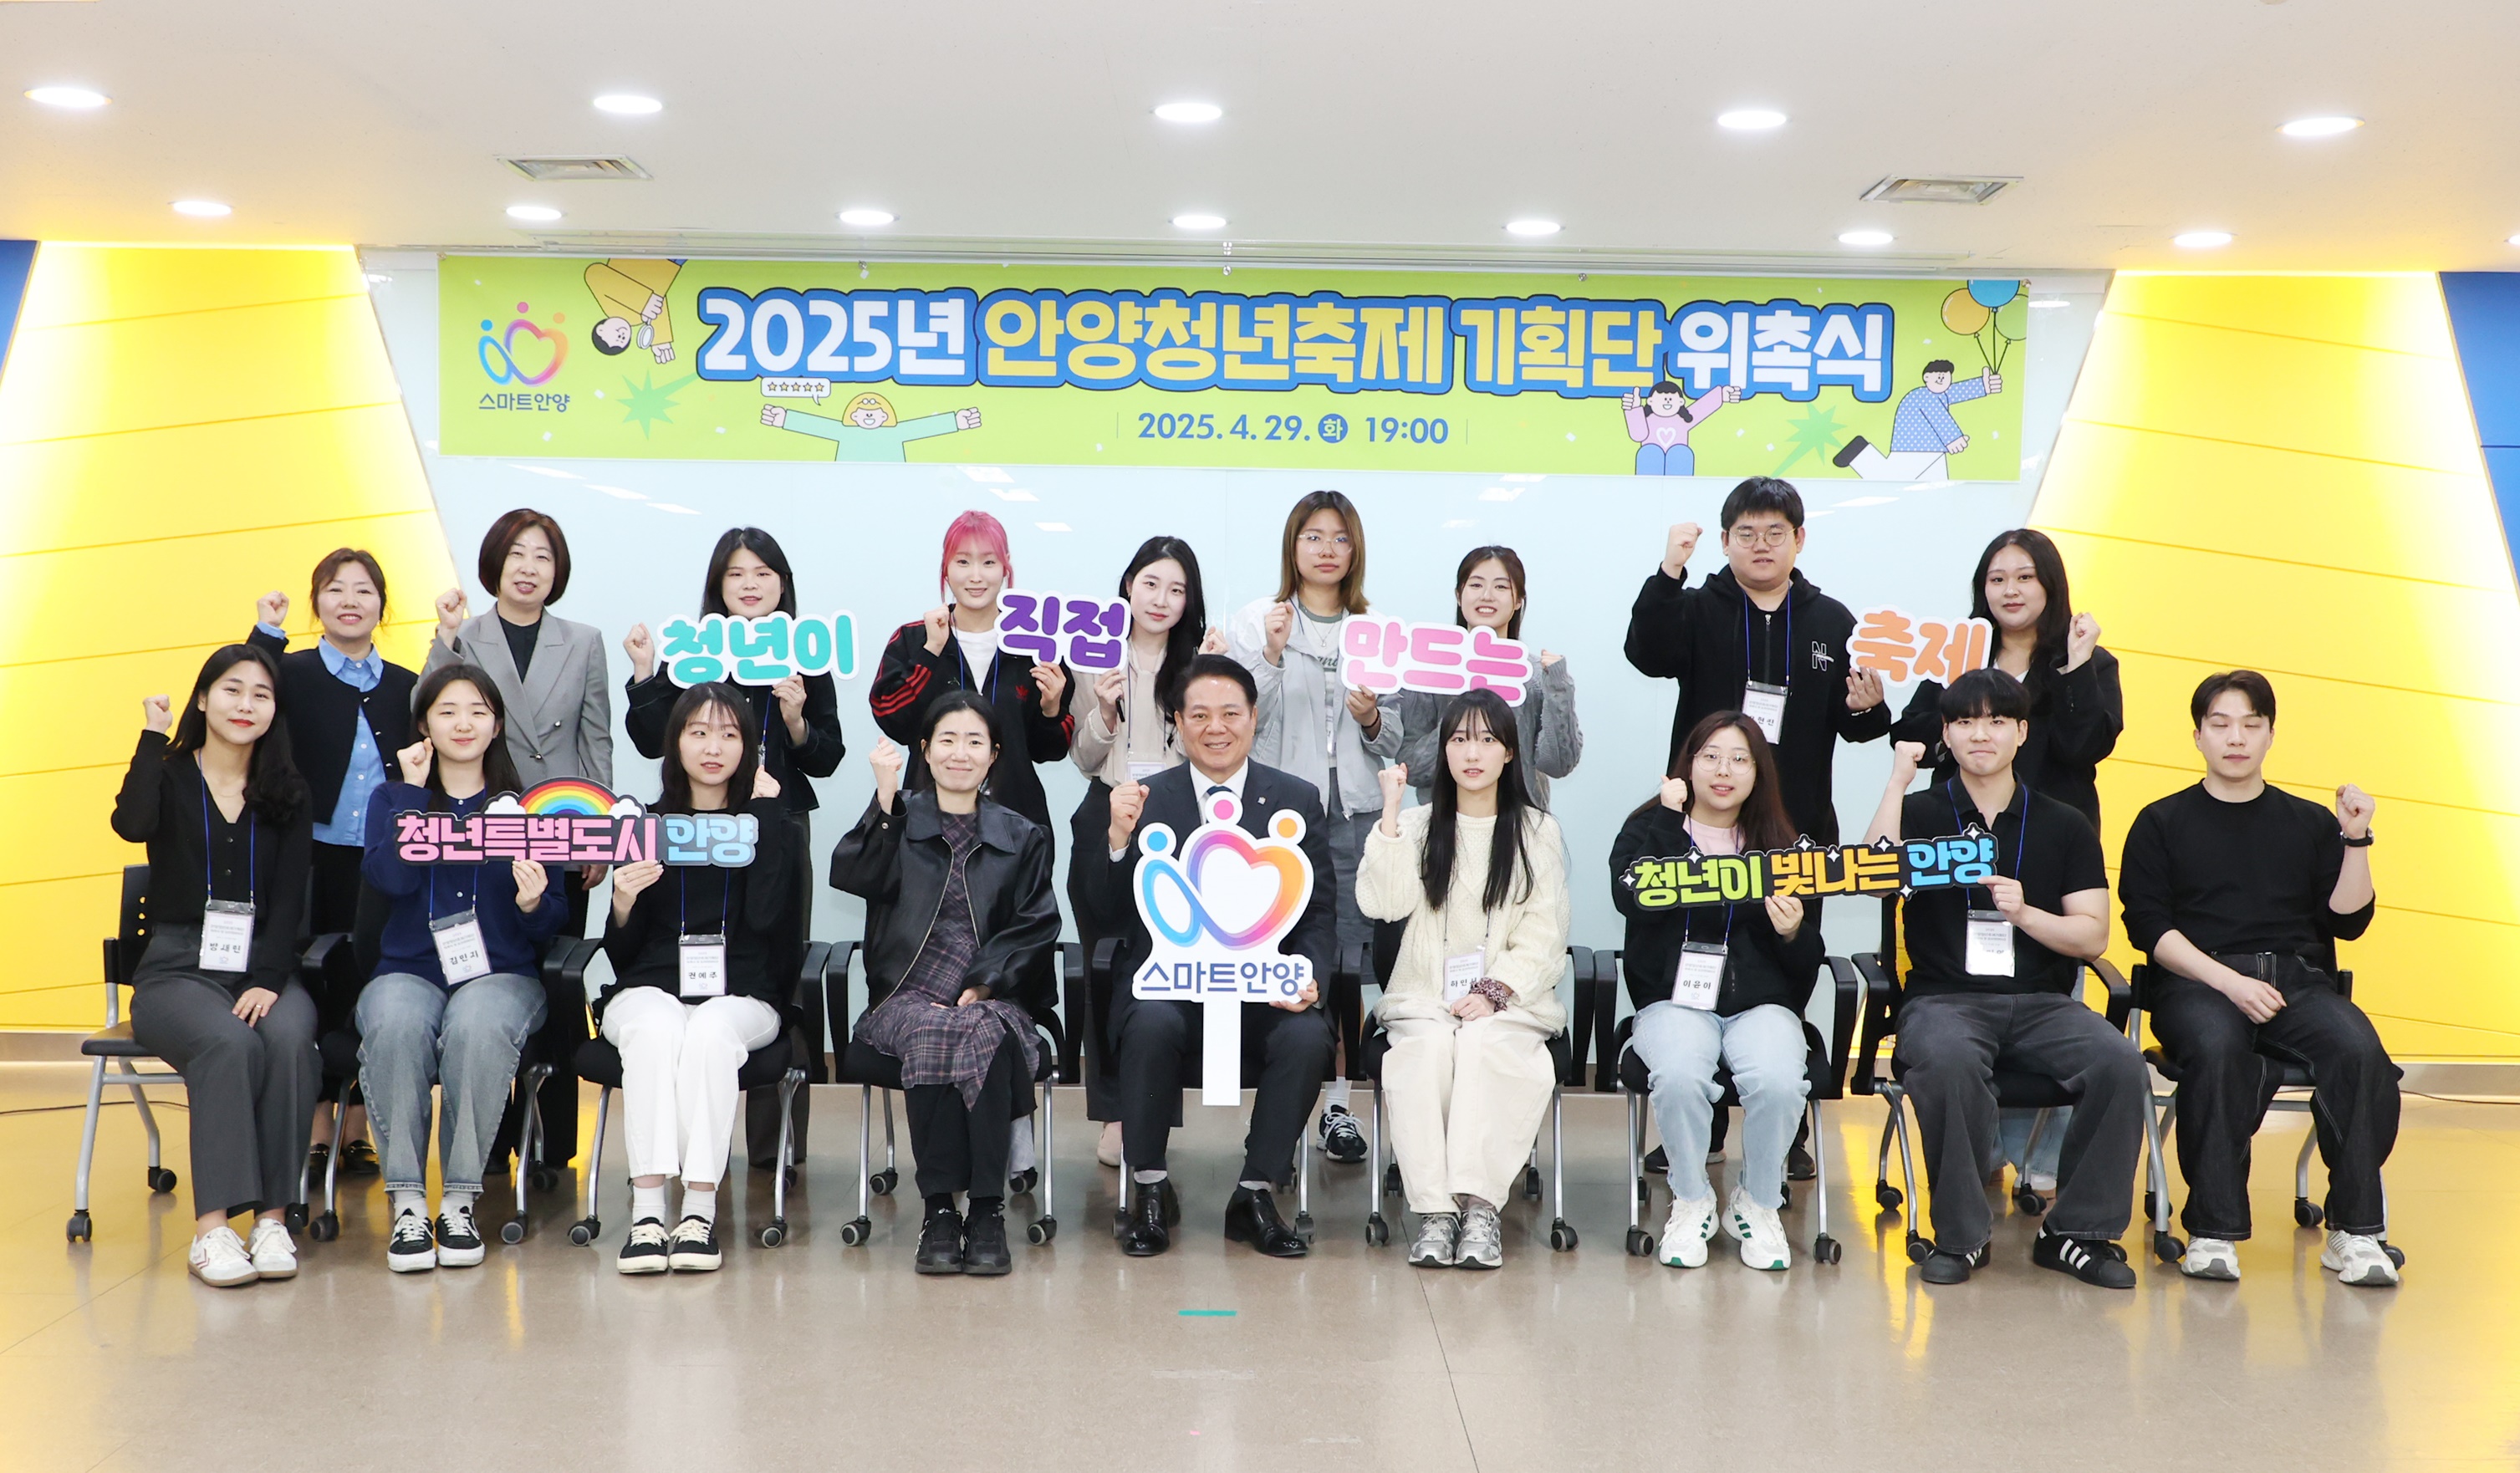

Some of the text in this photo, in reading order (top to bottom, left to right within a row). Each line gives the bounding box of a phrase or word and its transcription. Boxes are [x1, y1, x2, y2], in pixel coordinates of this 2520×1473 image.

[705, 298, 1884, 392] 2025년 안양청년축제 기획단 위촉식
[478, 392, 571, 413] 스마트안양
[1138, 412, 1223, 440] 2025.
[1366, 417, 1450, 445] 19:00
[663, 614, 855, 685] 청년이
[1000, 594, 1126, 670] 직접
[1344, 620, 1529, 702] 만드는
[1852, 610, 1987, 685] 축제
[396, 813, 757, 864] 청년특별도시 안양
[1635, 837, 1994, 907] 청년이 빛나는 안양
[448, 950, 479, 966] 김민지
[1140, 961, 1305, 996] 스마트안양
